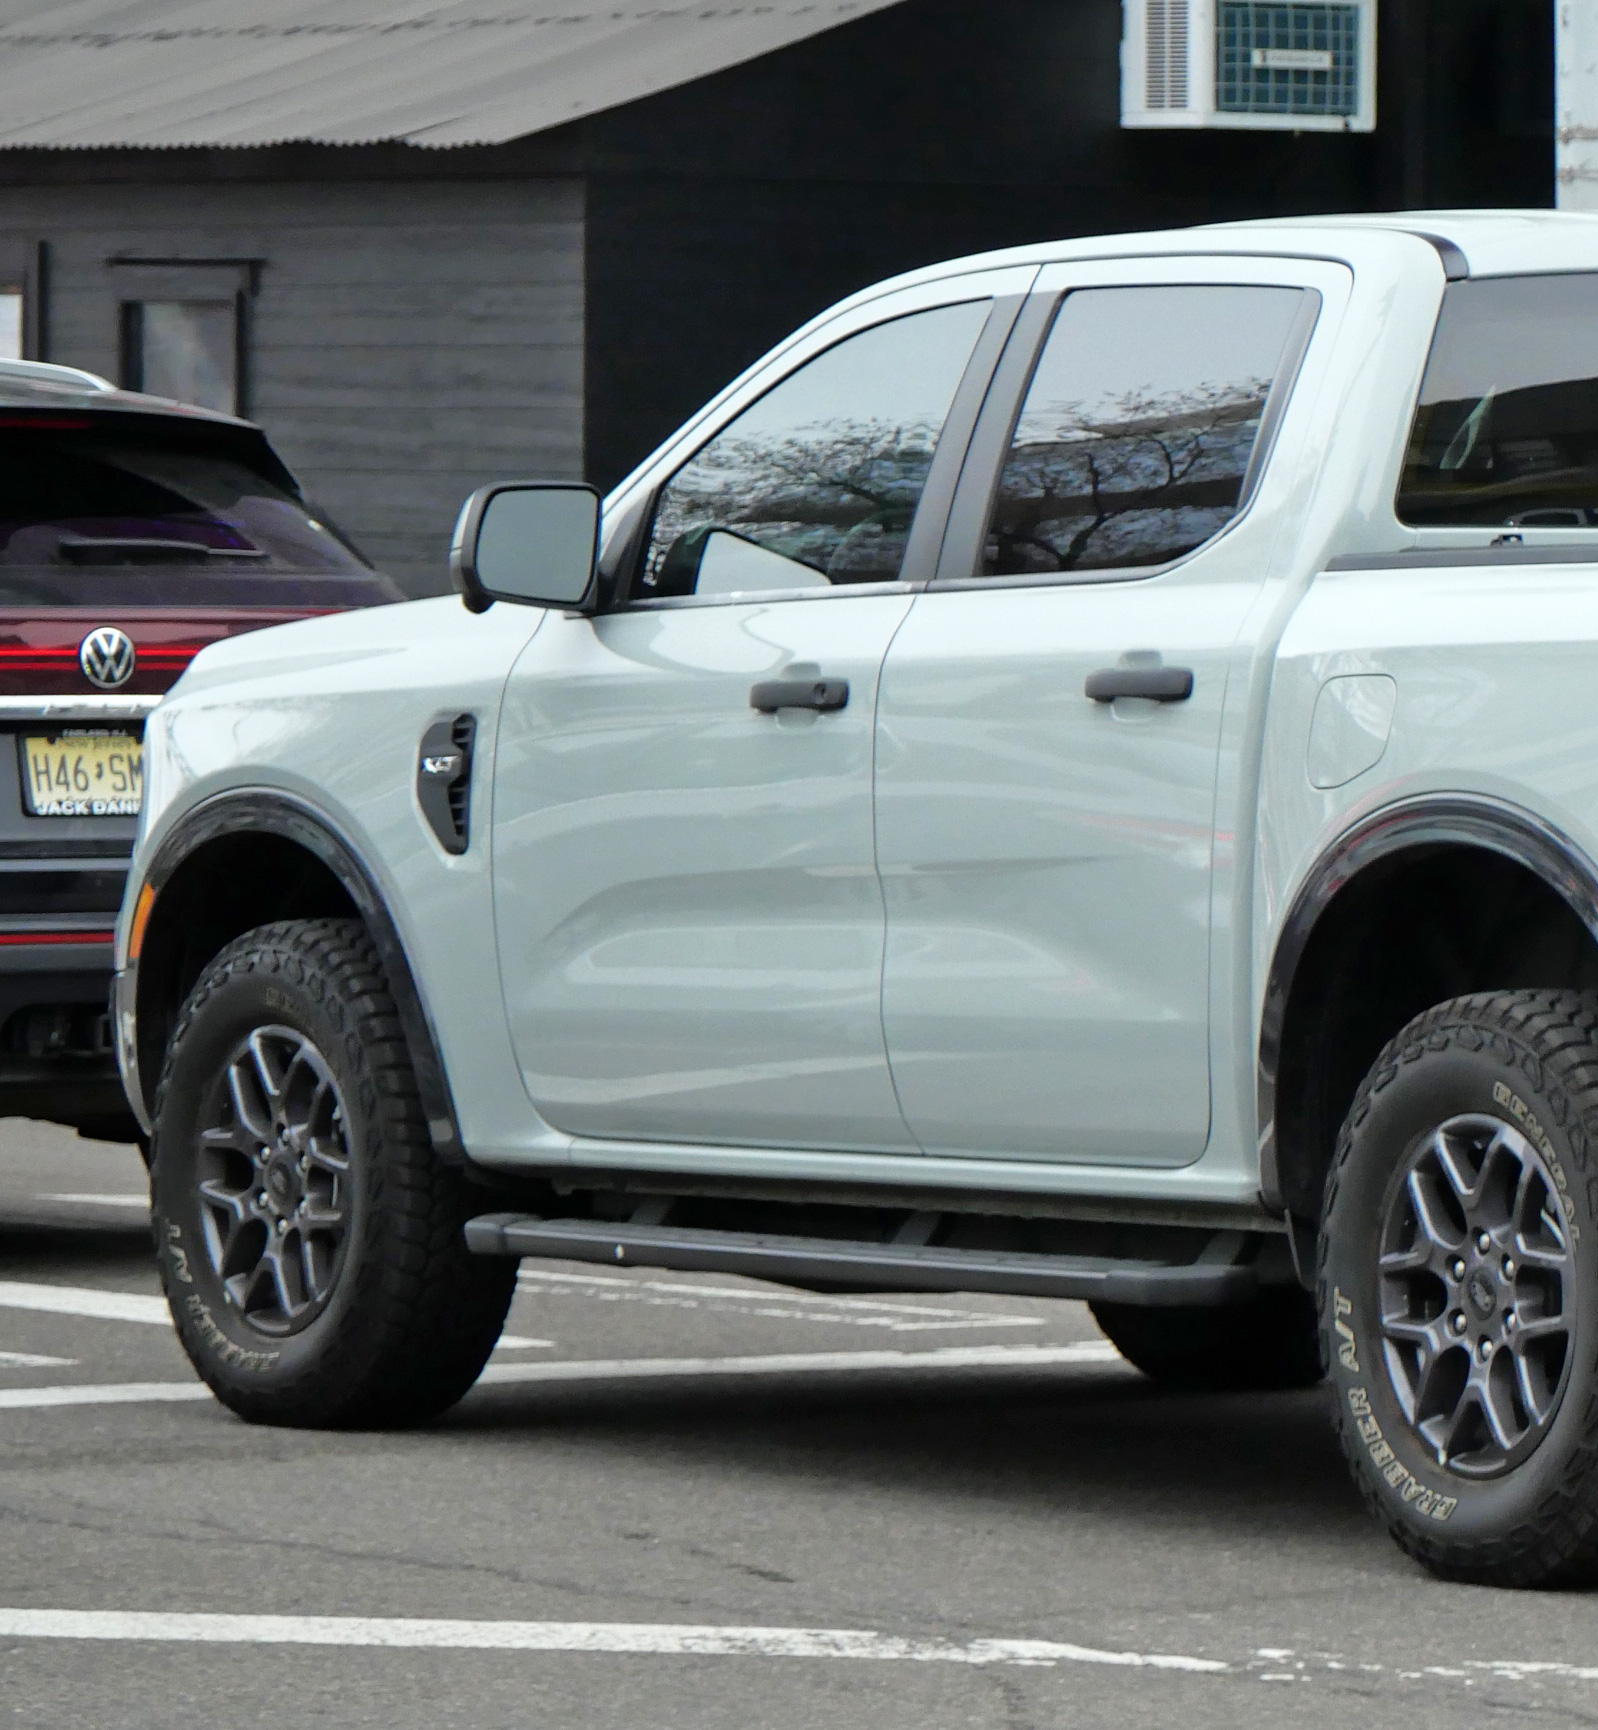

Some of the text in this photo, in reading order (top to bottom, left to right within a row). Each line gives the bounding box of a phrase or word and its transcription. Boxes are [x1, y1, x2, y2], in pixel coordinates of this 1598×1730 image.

[32, 753, 89, 792] H46
[36, 800, 89, 816] JACK
[1347, 1386, 1458, 1522] GRABBER
